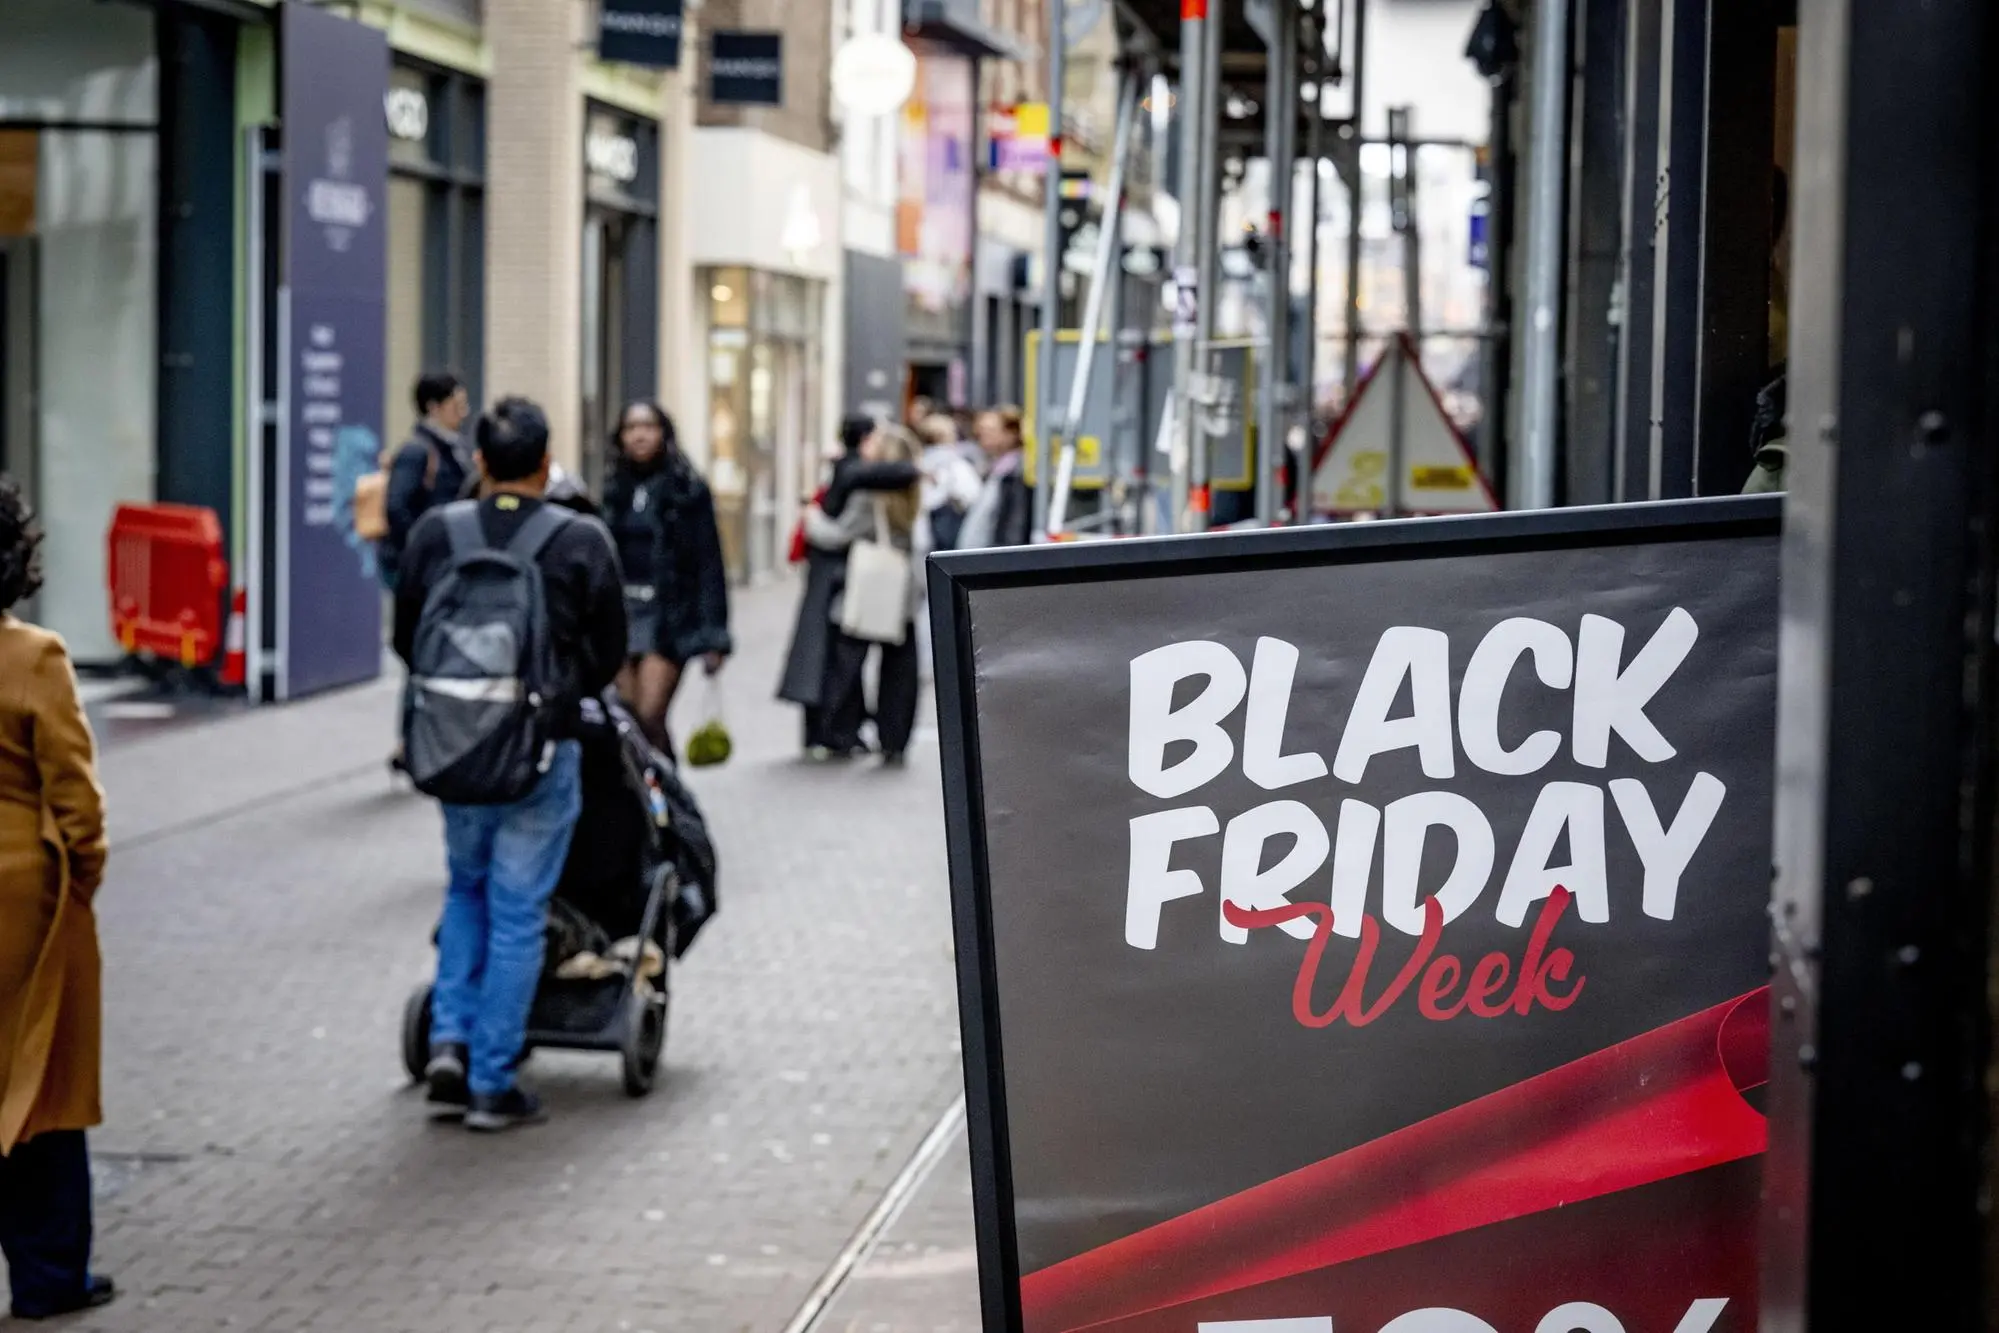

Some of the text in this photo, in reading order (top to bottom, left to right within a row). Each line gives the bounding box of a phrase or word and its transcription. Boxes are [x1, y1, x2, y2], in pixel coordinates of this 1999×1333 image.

[1128, 607, 1699, 799] BLACK
[1125, 772, 1726, 951] FRIDAY
[1223, 885, 1586, 1029] Week
